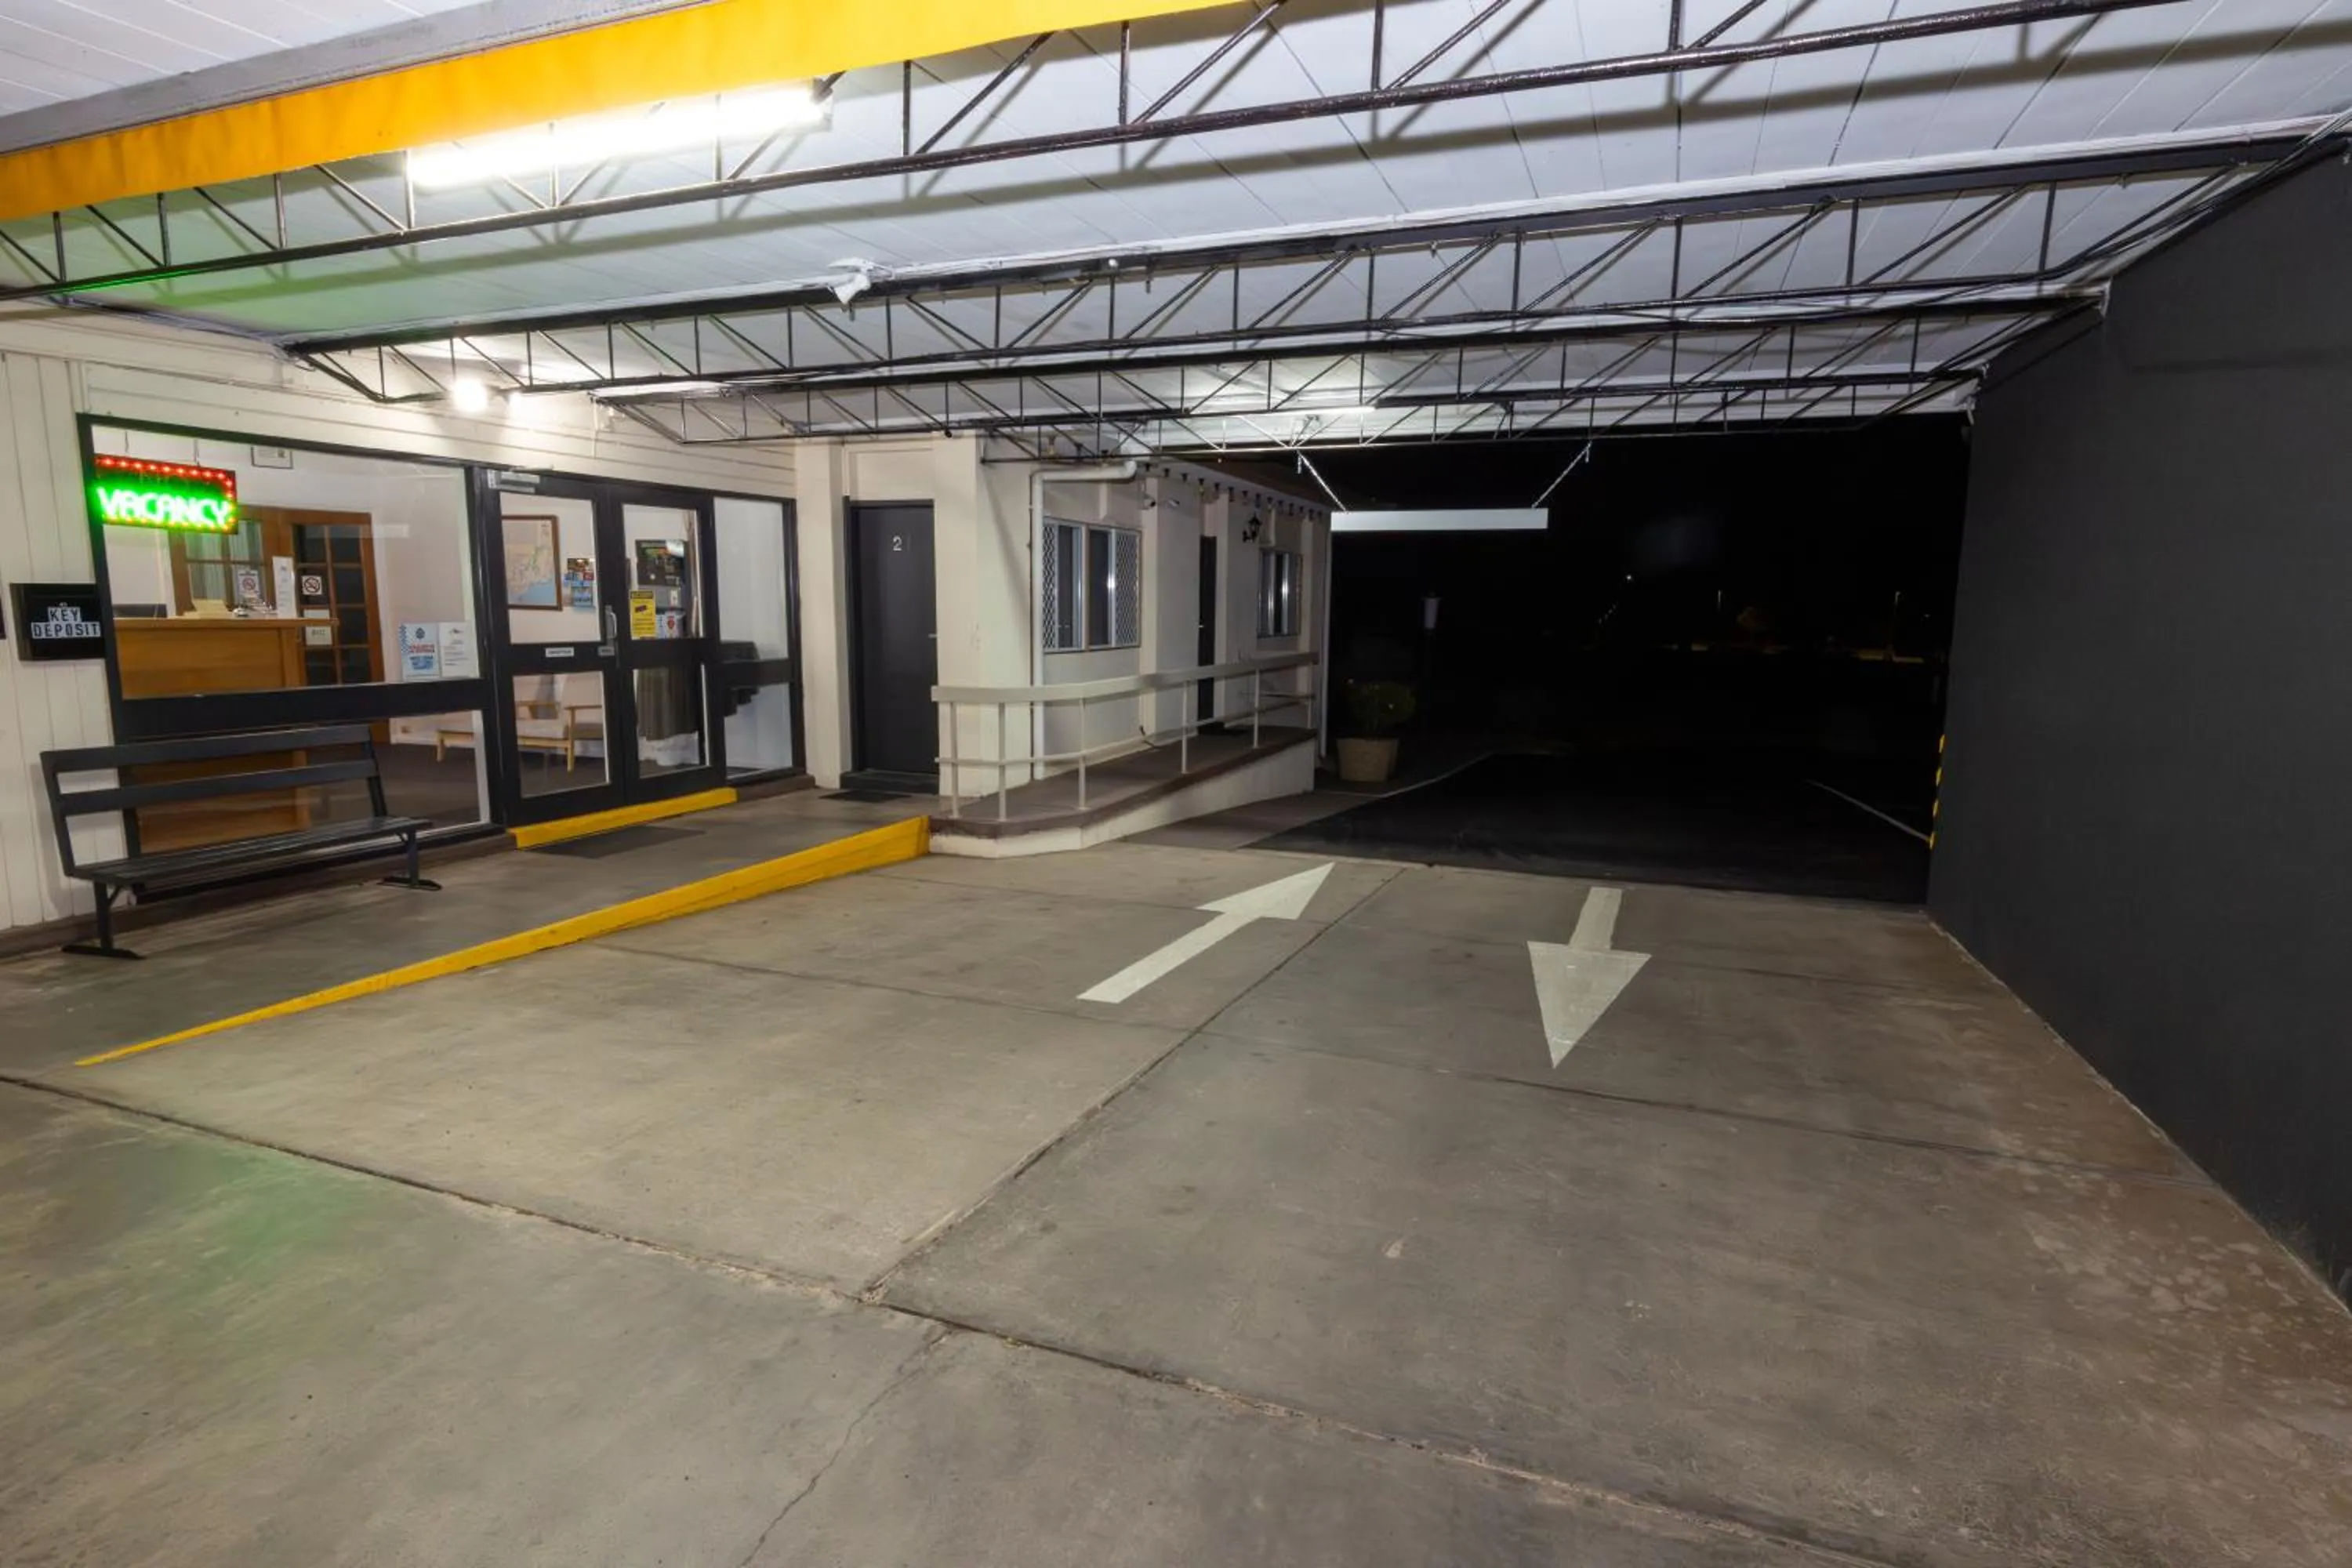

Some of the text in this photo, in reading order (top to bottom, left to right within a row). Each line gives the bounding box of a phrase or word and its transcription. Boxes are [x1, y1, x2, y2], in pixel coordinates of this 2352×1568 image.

[96, 486, 230, 526] VACANCY
[893, 535, 902, 551] 2
[49, 608, 78, 622] KEY
[33, 623, 98, 637] DEPOSIT
